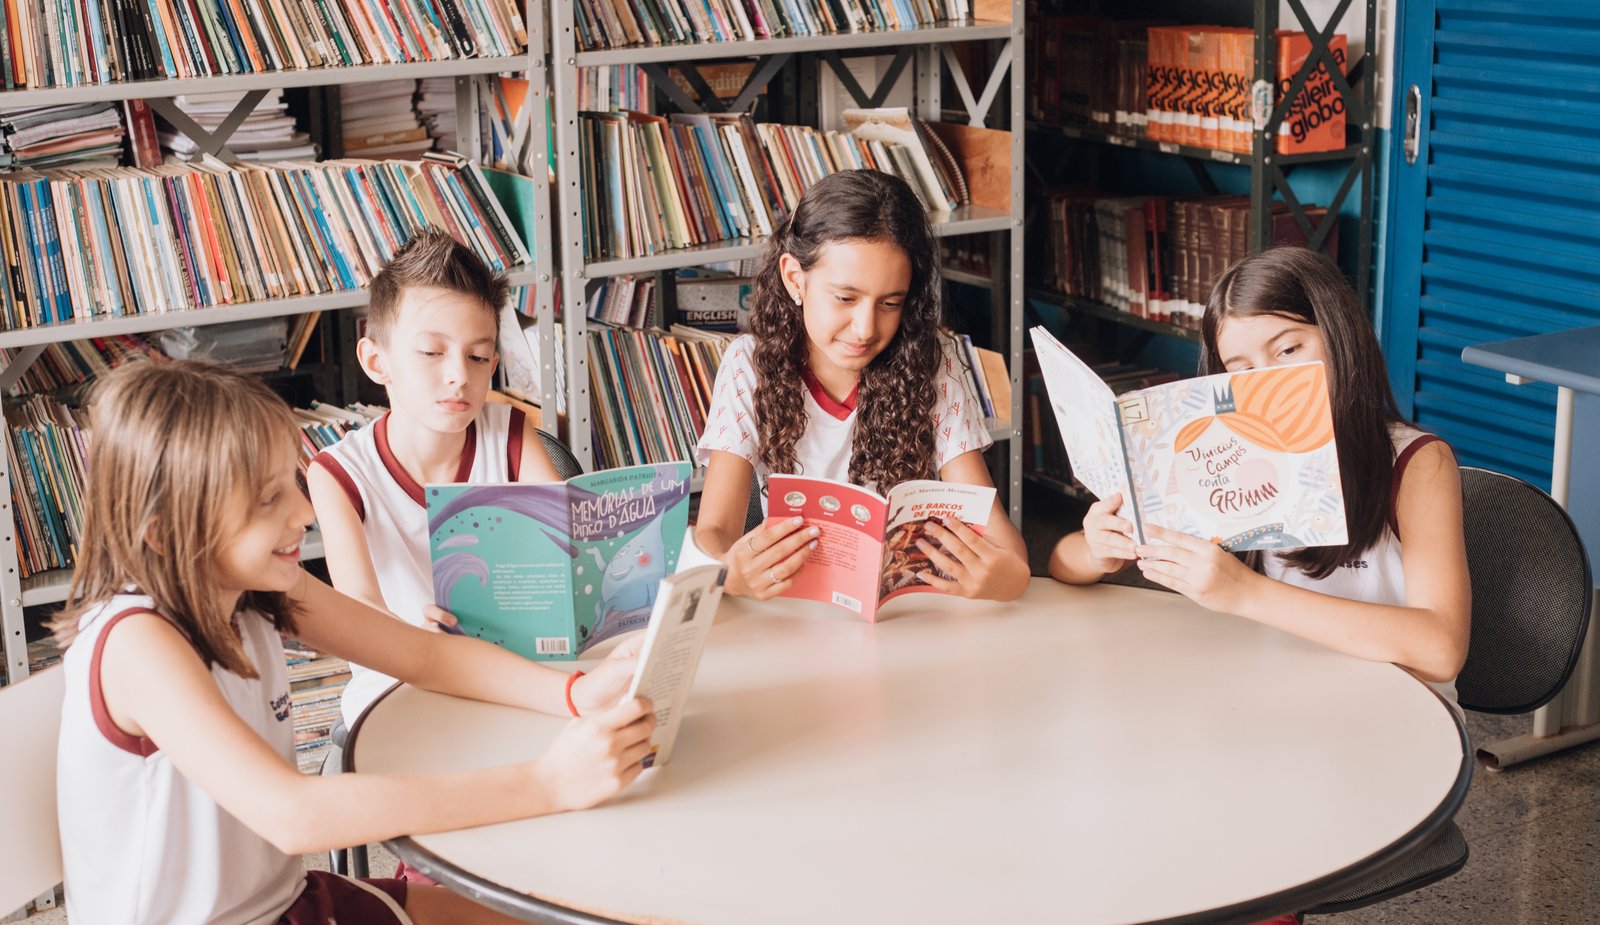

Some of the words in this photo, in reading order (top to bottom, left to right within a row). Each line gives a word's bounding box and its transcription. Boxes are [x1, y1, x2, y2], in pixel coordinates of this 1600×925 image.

[1290, 96, 1346, 144] globo
[686, 310, 738, 321] ENGLISH
[1185, 436, 1238, 462] Vinicius
[1206, 445, 1247, 475] Campos
[590, 475, 628, 488] MARGARIDA
[629, 471, 662, 481] PATRIOTA
[1198, 473, 1231, 488] conta
[572, 487, 635, 522] MEMÓRIAS
[641, 482, 655, 496] DE
[660, 479, 685, 495] UM
[911, 503, 924, 512] OS
[926, 502, 964, 511] BARCOS
[914, 510, 926, 518] DE
[928, 510, 957, 518] PAPEL
[572, 520, 603, 539] PINGO
